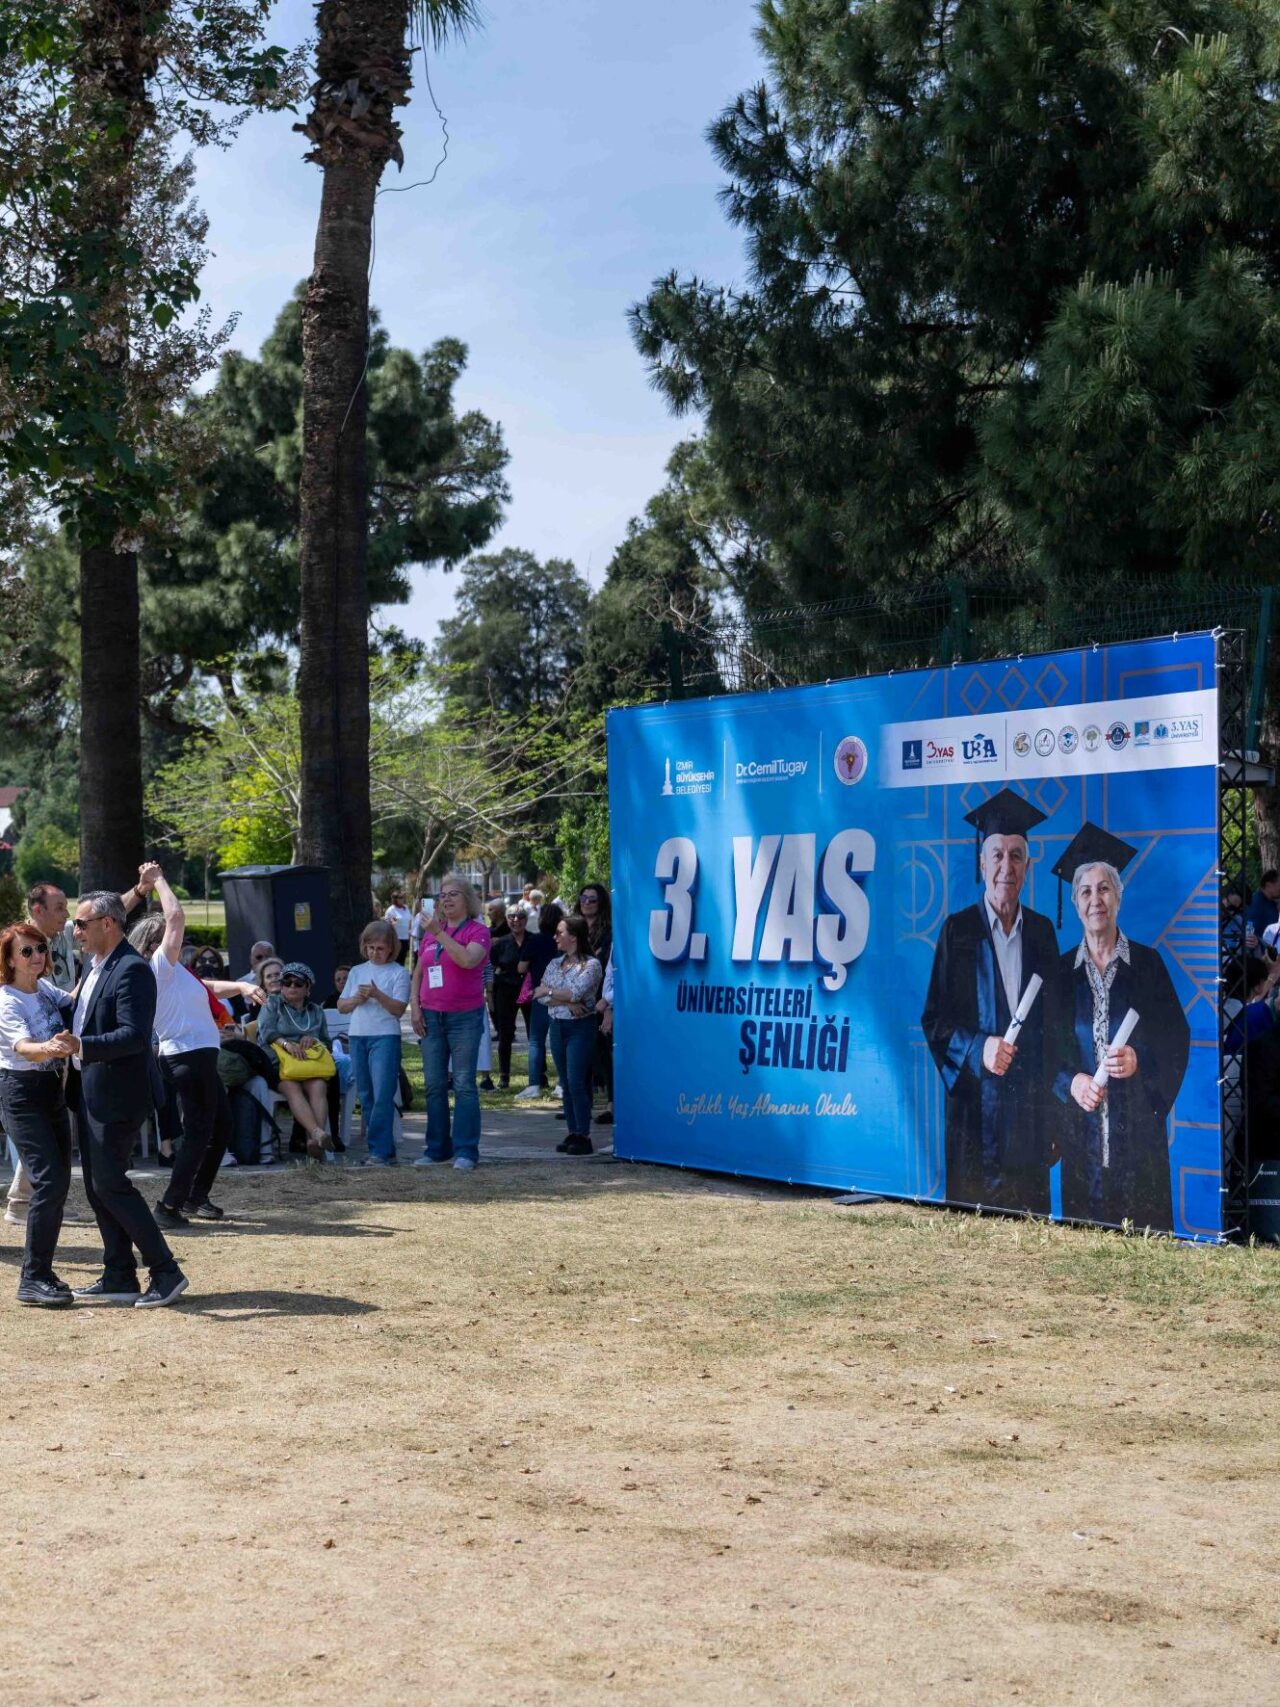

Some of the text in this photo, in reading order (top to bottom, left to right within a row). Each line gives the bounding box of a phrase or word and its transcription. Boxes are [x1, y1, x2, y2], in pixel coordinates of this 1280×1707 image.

[676, 770, 715, 783] BÜYÜKŞEHİR
[676, 782, 711, 795] BELEDİYESİ
[648, 828, 877, 991] 3. YAŞ
[677, 980, 813, 1018] ÜNİVERSİTELERİ
[738, 1014, 850, 1075] ŞENLİĞİ
[677, 1092, 858, 1125] Sağlıklı Yaş Almanın Okulu
